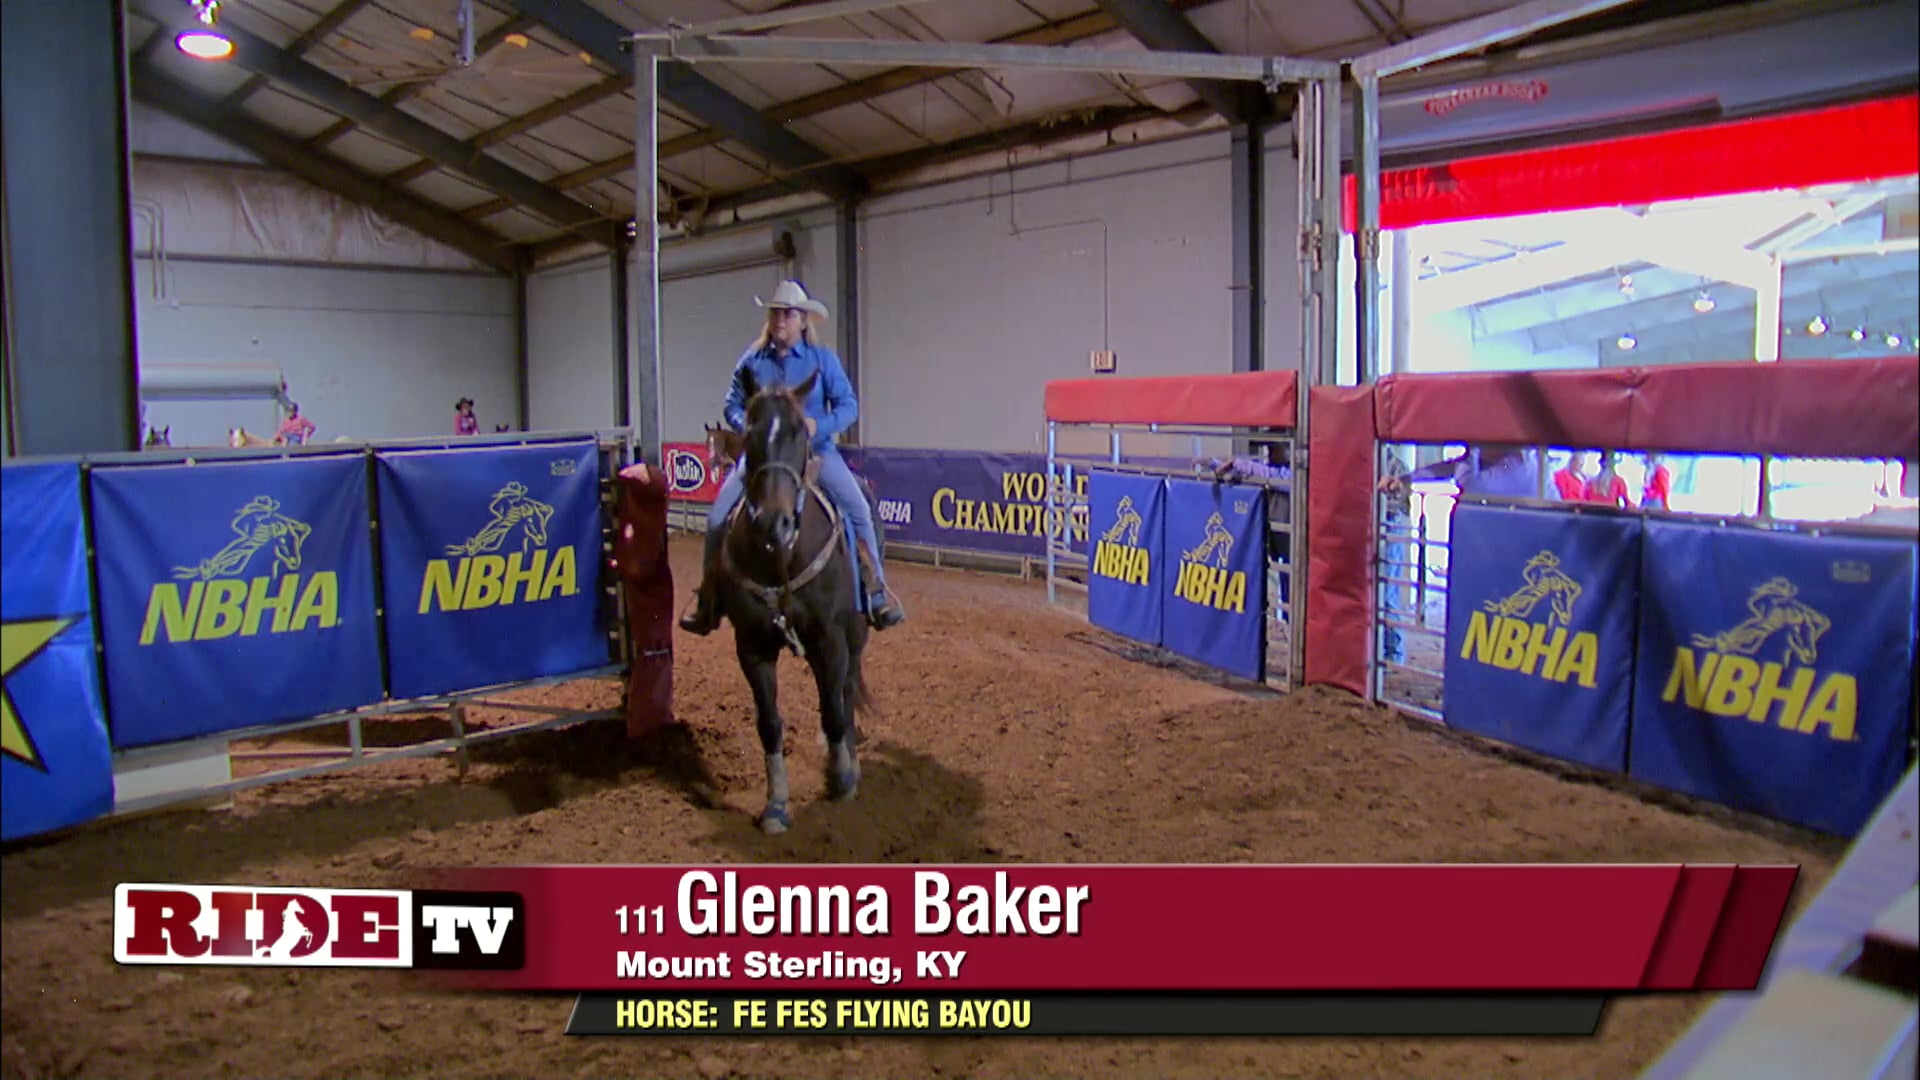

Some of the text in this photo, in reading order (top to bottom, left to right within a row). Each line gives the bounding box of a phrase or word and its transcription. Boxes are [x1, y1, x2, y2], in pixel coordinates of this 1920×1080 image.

[418, 545, 577, 614] NBHA
[1093, 540, 1150, 586] NBHA
[1174, 559, 1247, 614] NBHA
[139, 571, 340, 646] NBHA
[1460, 611, 1598, 688] NBHA
[1661, 646, 1858, 742] NBHA
